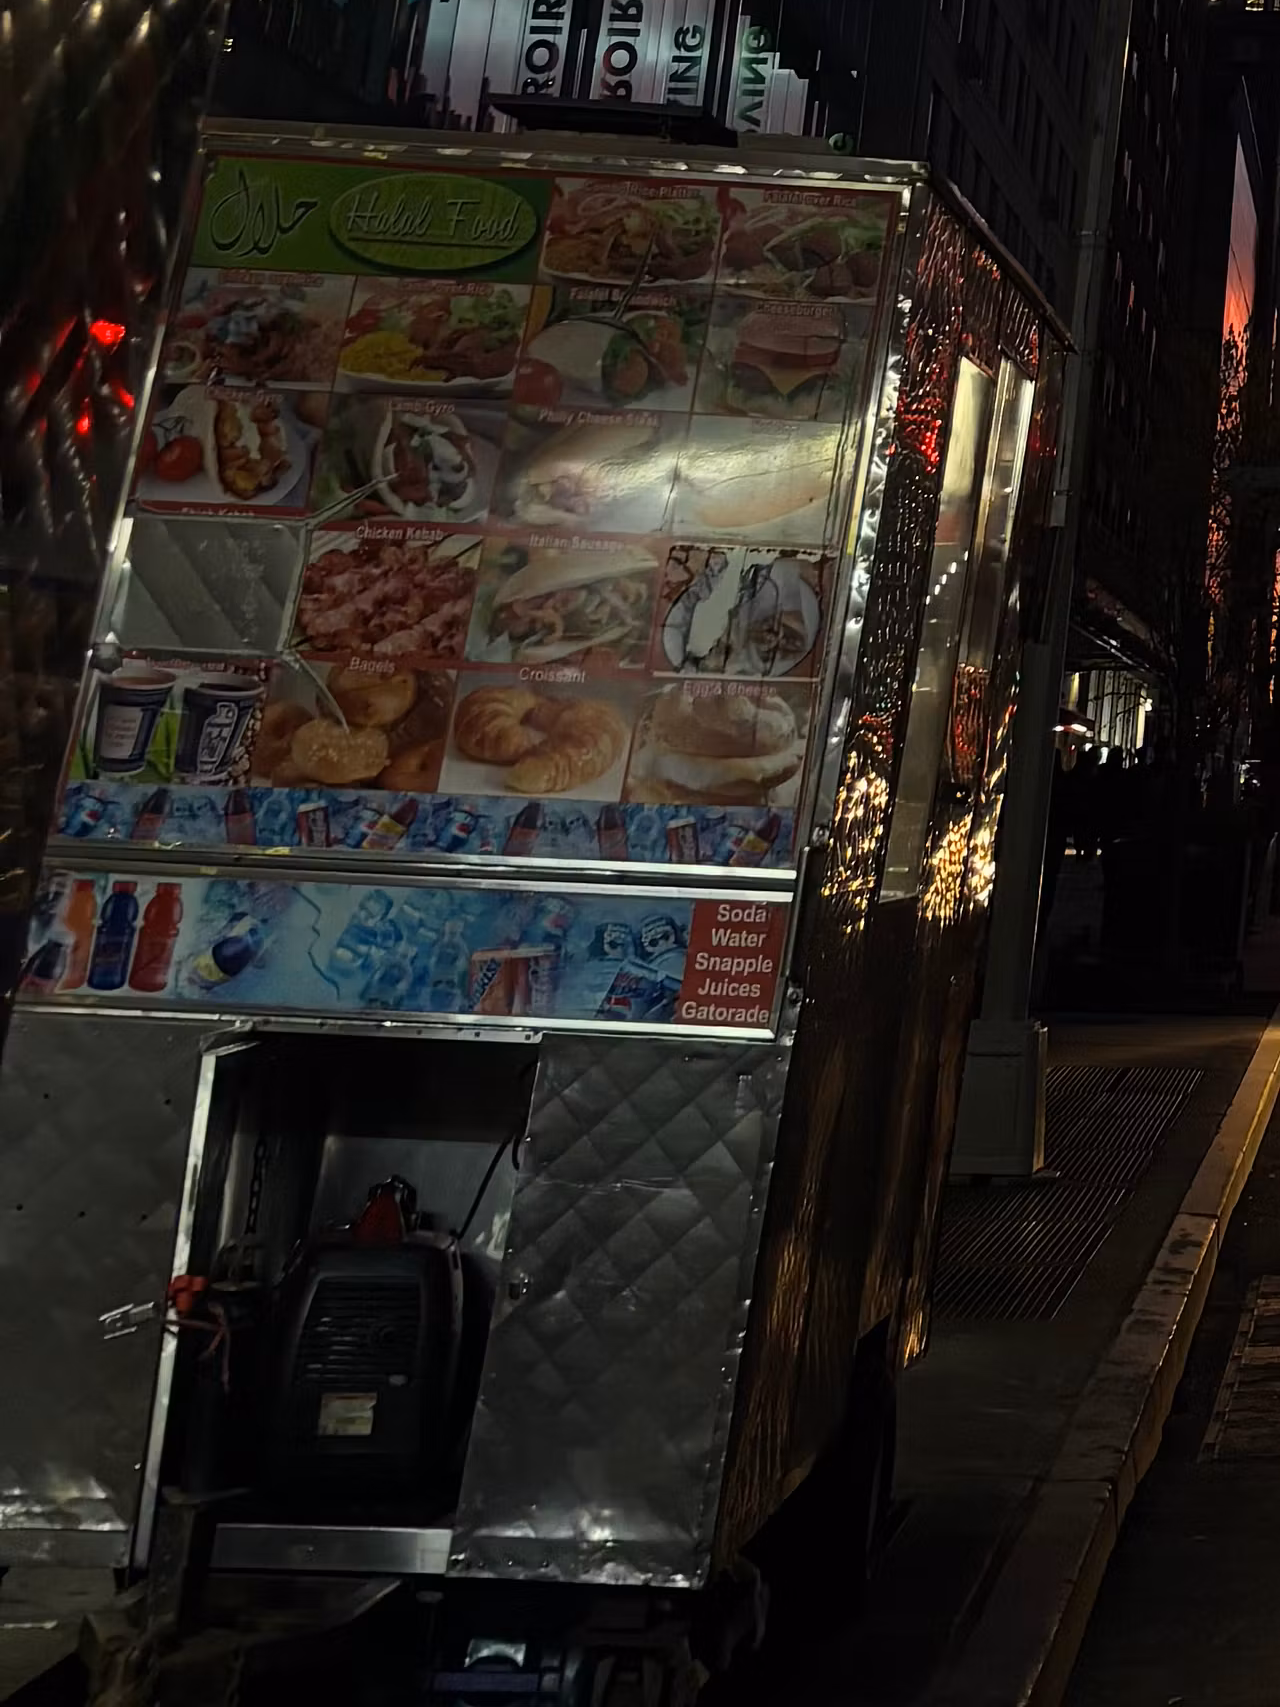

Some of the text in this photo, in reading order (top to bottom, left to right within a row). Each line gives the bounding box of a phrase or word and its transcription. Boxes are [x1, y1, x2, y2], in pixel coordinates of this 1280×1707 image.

[666, 24, 705, 106] ING
[346, 191, 522, 242] Halal Food
[356, 525, 445, 541] Chicken Kebab
[529, 533, 568, 548] Italian
[349, 656, 396, 674] Bagels
[519, 667, 586, 684] Croissant
[717, 904, 767, 922] Soda
[711, 928, 767, 947] Water
[695, 952, 773, 976] Snapple
[697, 978, 761, 997] Juices
[681, 1001, 770, 1023] Gatorade
